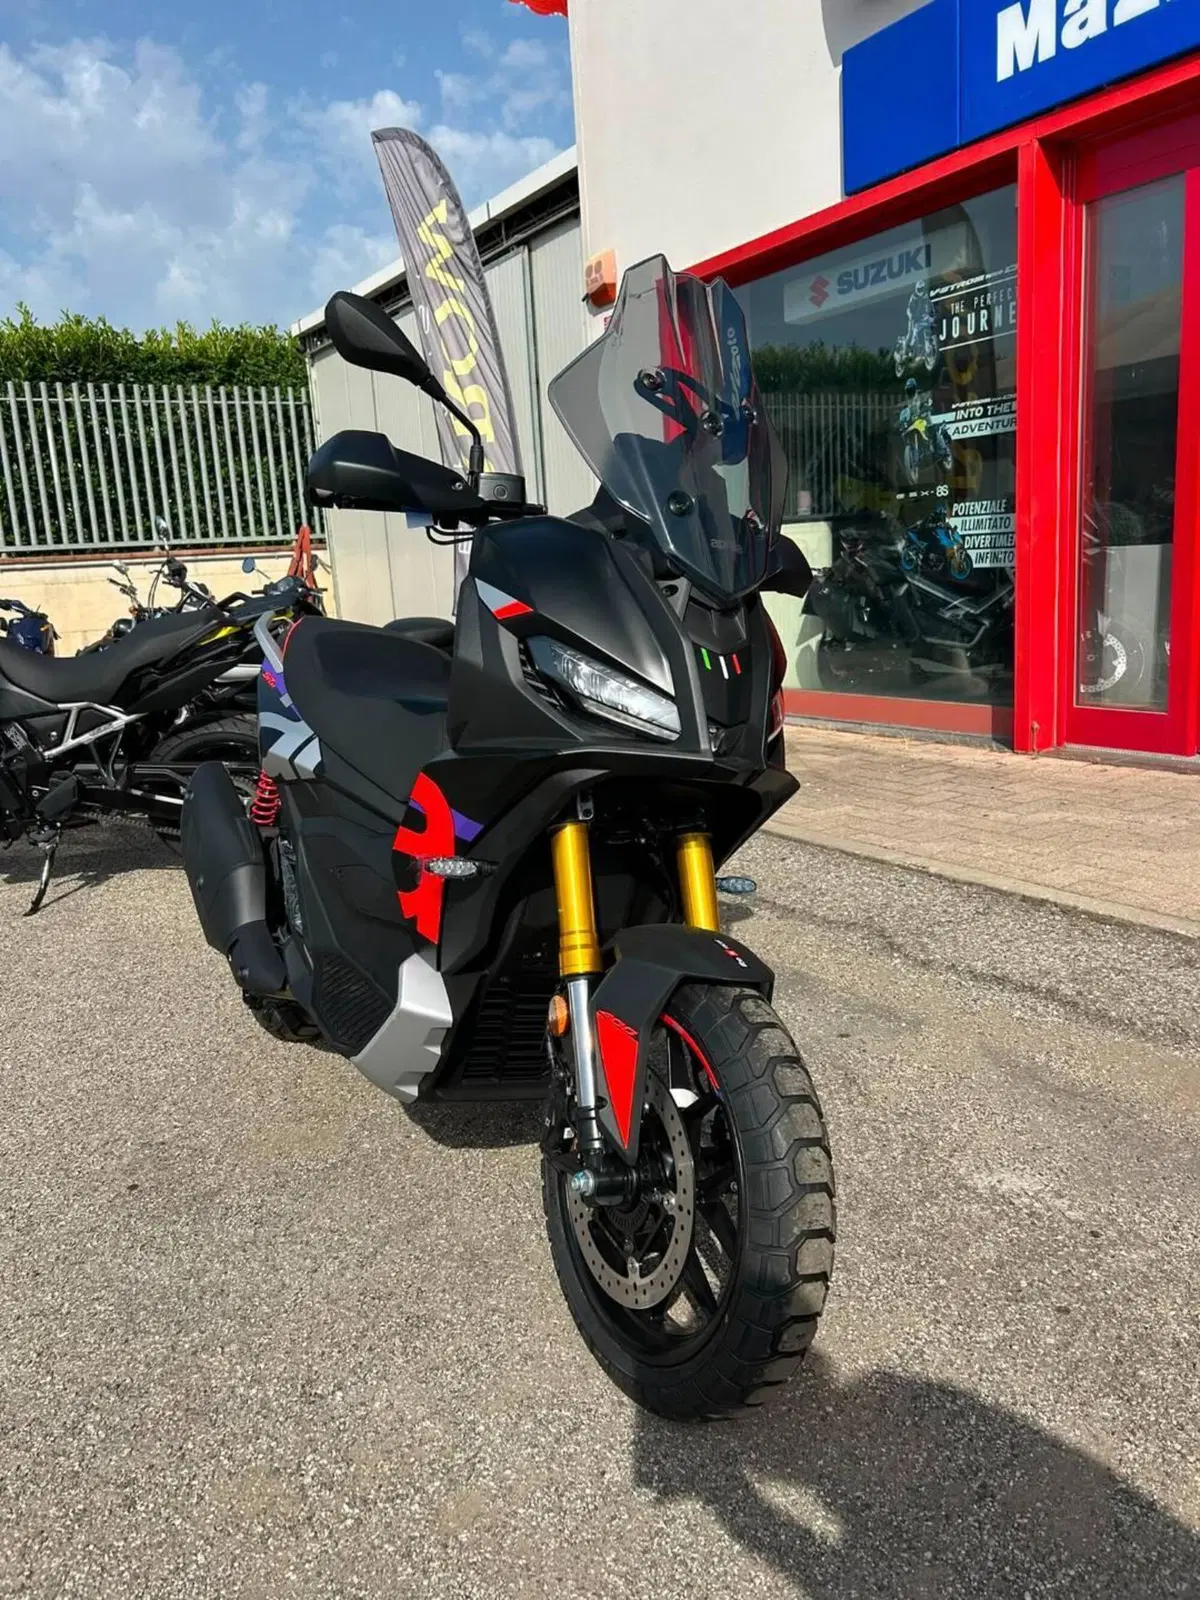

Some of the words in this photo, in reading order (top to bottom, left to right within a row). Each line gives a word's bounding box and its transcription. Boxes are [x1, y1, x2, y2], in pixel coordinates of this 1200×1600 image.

[837, 243, 931, 296] SUZUKI
[950, 300, 964, 315] THE
[973, 286, 1018, 309] PERFEC
[938, 301, 1017, 341] JOURNE
[956, 406, 983, 420] INTO
[987, 401, 1011, 416] THE
[952, 417, 1017, 436] ADVENTUR
[952, 499, 1007, 516] POTENZIALE
[961, 516, 1011, 532] ILLIMITATO
[964, 533, 1015, 549] DIVERTIME
[975, 550, 1014, 564] INFINITO
